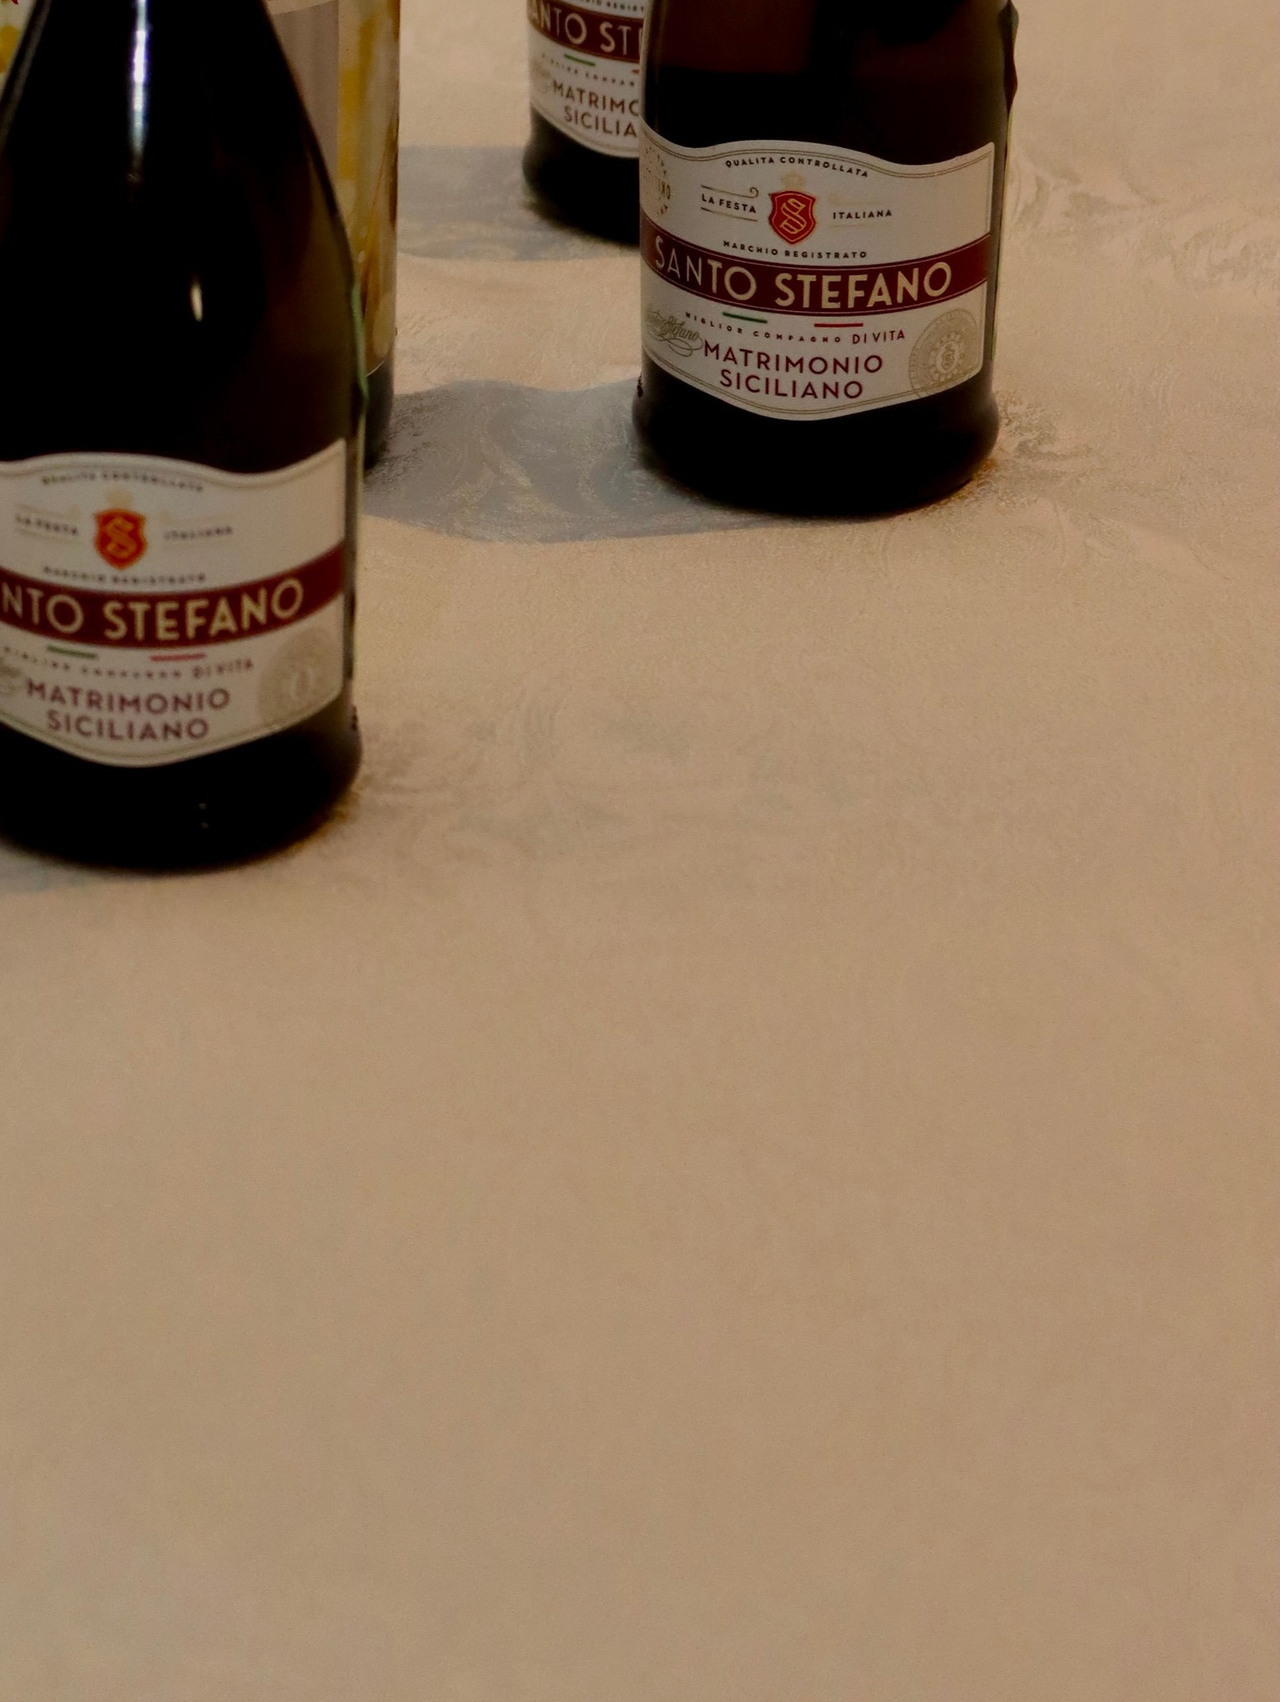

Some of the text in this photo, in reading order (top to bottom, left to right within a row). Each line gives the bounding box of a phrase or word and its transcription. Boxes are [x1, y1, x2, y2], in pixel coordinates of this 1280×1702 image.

[553, 79, 639, 117] MATRIMO
[564, 106, 637, 138] SICILIA
[725, 155, 869, 178] QUALITA CONTROLLATA
[700, 193, 758, 214] LA FESTA
[832, 208, 893, 220] ITALIANA
[723, 240, 868, 260] MARCHIO REGISTRATO
[654, 234, 952, 309] SANTO STEFANO
[704, 338, 884, 376] MATRIMONIO
[720, 368, 863, 399] SICILIANO
[104, 577, 305, 641] STEFANO
[26, 679, 231, 716] MATRIMONIO
[47, 709, 210, 741] SICILIANO
